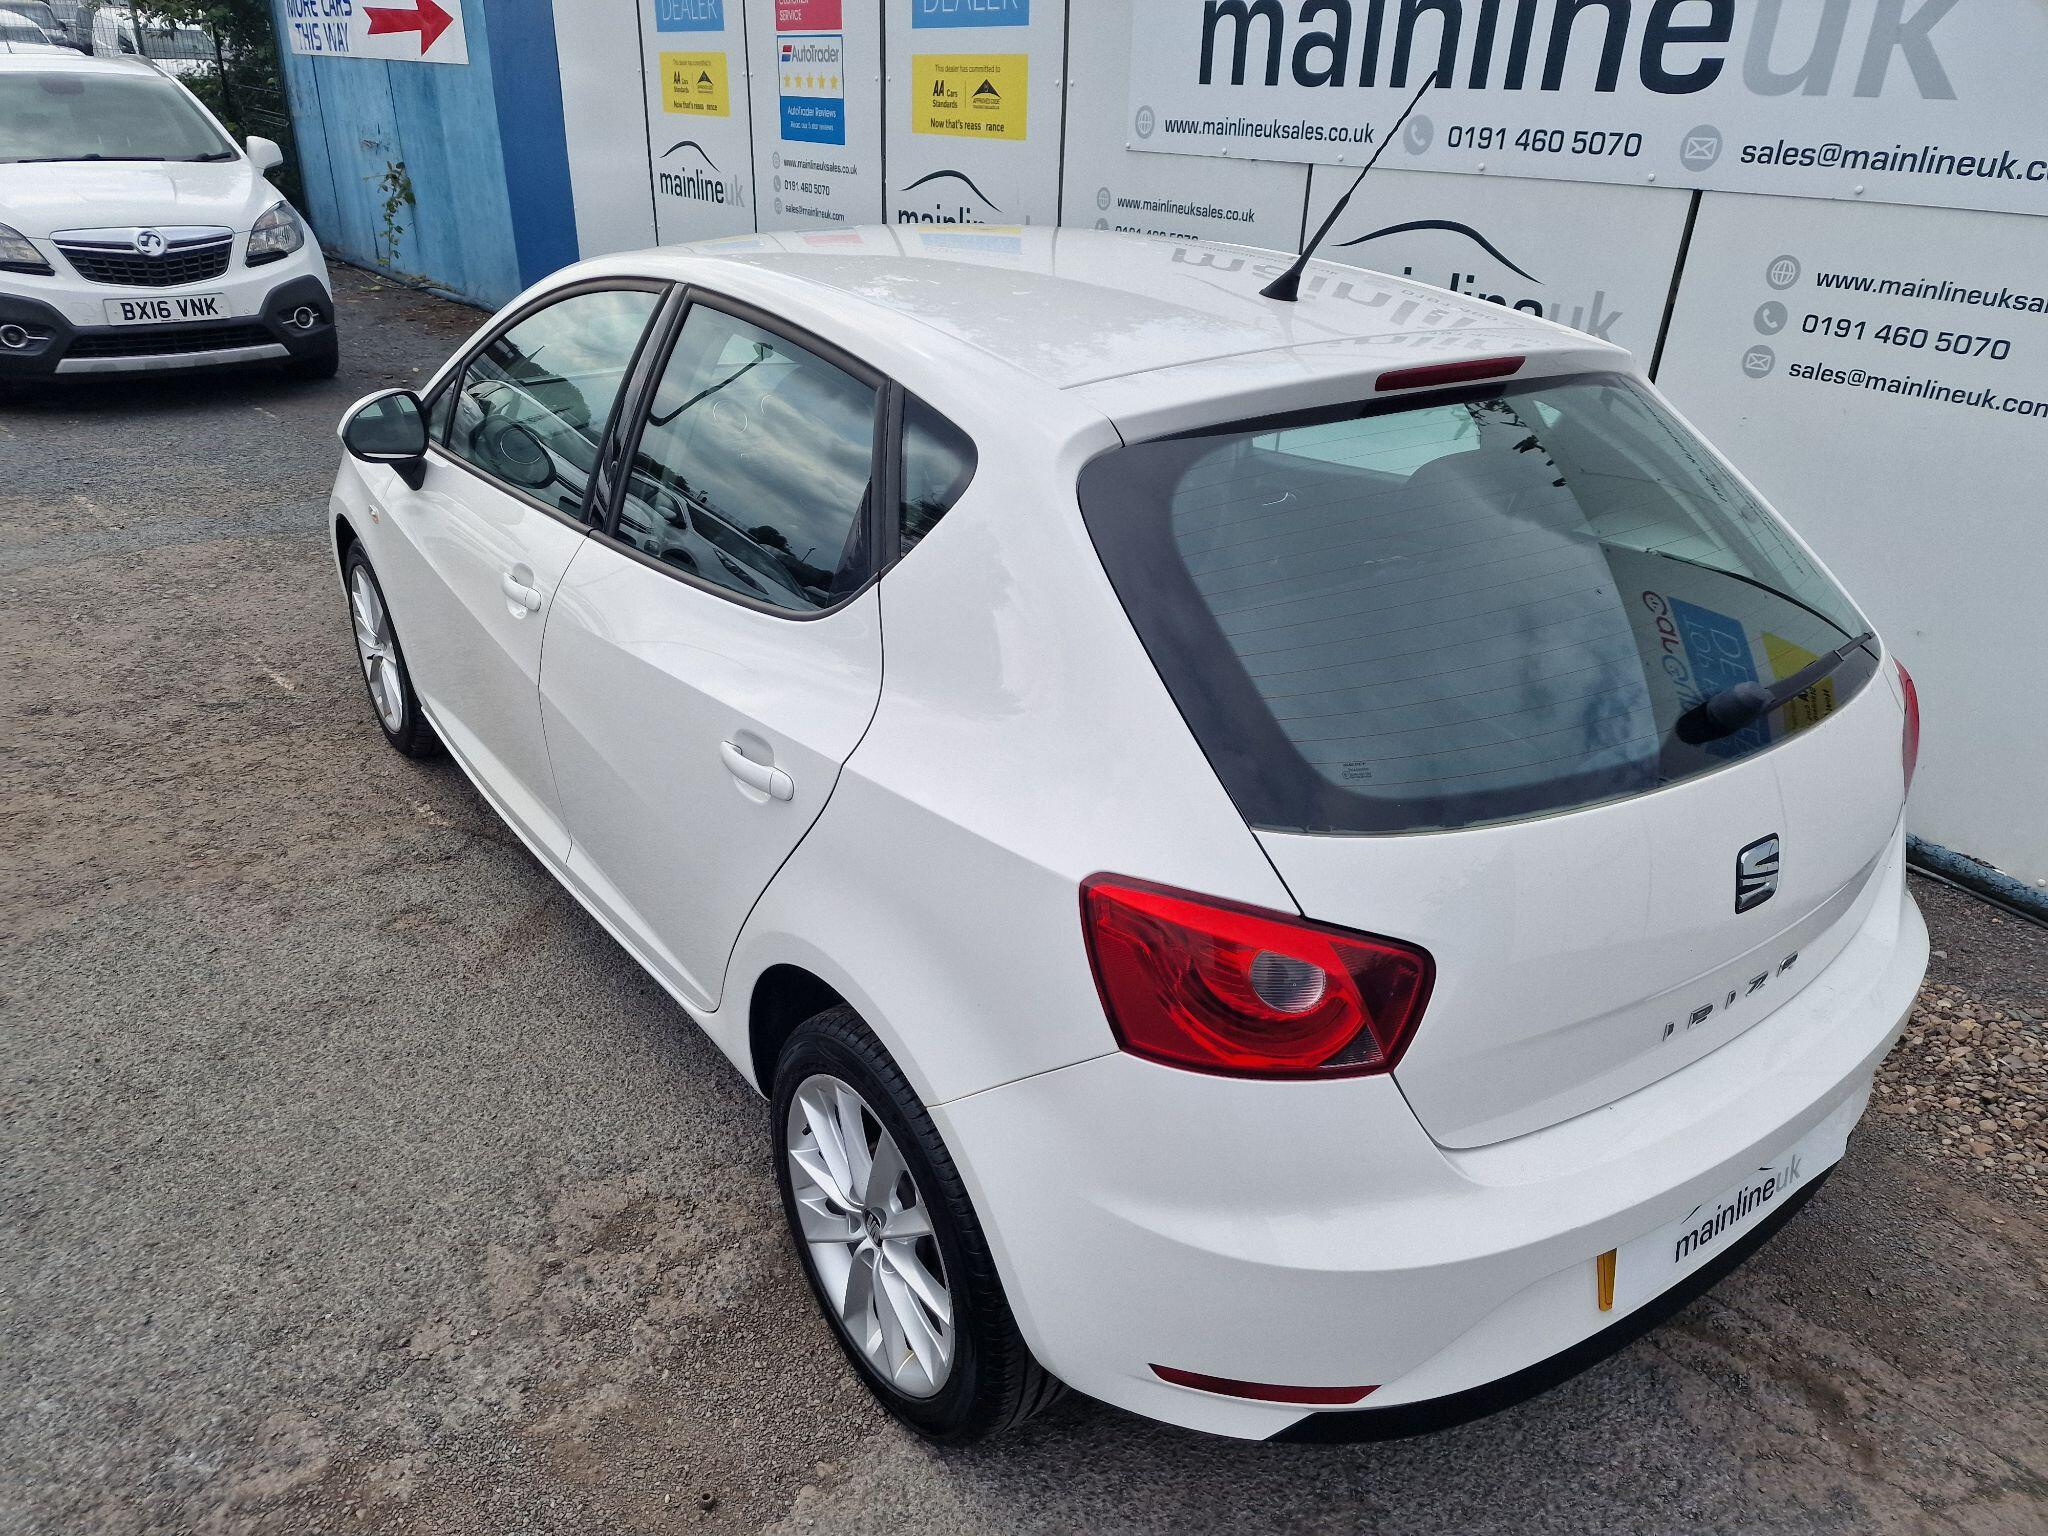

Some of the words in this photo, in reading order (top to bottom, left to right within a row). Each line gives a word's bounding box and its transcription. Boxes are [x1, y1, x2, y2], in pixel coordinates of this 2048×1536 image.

[287, 0, 319, 18] MORE
[320, 0, 353, 18] CARS
[294, 22, 323, 51] THIS
[322, 22, 350, 52] WAY
[791, 44, 840, 63] AutoTrader
[933, 79, 945, 97] AA
[946, 88, 958, 98] Cars
[932, 99, 958, 109] Standards
[930, 117, 945, 129] Now
[945, 118, 963, 130] that's
[1164, 117, 1375, 144] www.mainlineuksales.co.uk
[1447, 125, 1507, 150] 0191
[1515, 128, 1565, 153] 460
[1571, 130, 1643, 158] 5070
[1740, 139, 2048, 182] sales@mainlineuk.c
[659, 166, 745, 208] mainlineuk
[784, 179, 800, 192] 0191
[800, 182, 813, 194] 460
[813, 184, 830, 196] 5070
[1117, 196, 1256, 223] www.mainlineuksales.co.uk
[119, 300, 173, 321] BX16
[175, 296, 219, 318] VNK
[1802, 313, 1867, 341] 0191
[1873, 324, 1930, 350] 460
[1934, 331, 2011, 361] 5070
[1674, 1153, 1802, 1264] mainlineuk
